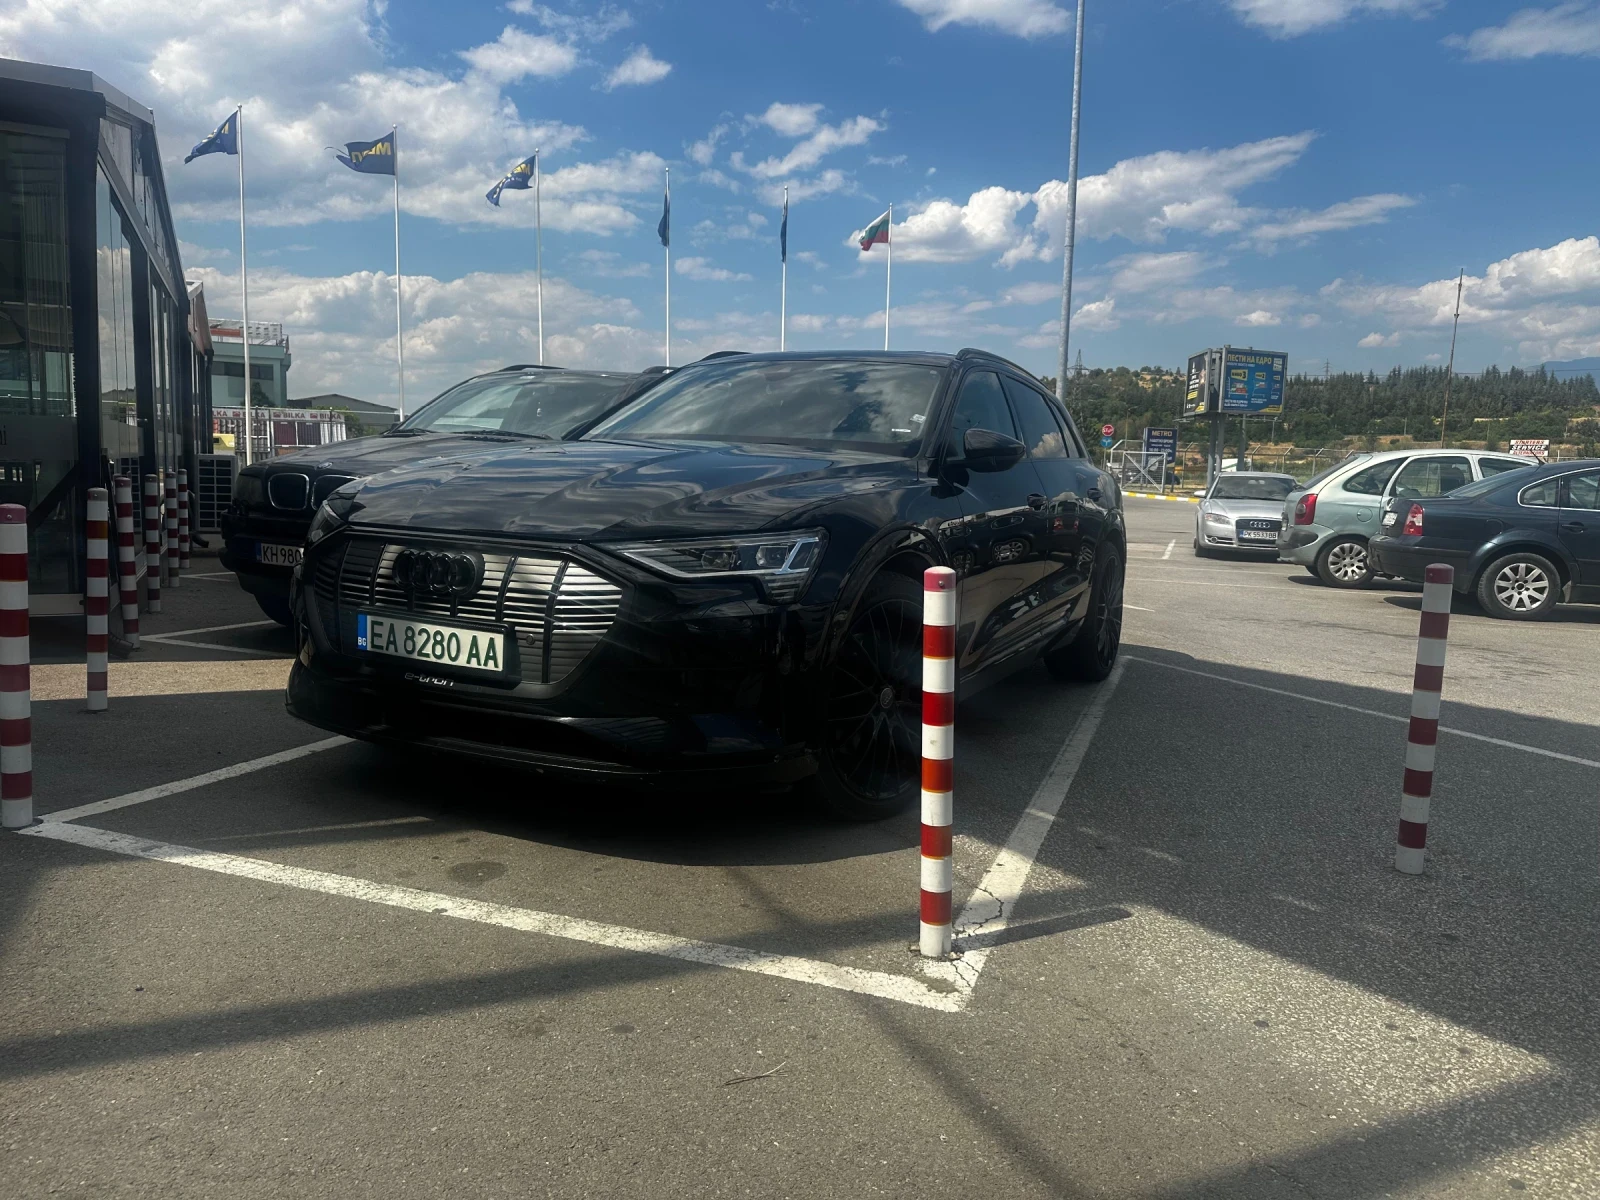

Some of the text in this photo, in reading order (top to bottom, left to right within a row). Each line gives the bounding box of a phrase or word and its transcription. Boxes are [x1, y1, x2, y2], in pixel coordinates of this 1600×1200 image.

[1227, 354, 1246, 362] ПЕСТИ
[1247, 355, 1255, 363] НА
[1256, 356, 1272, 365] ЕДРО
[283, 411, 306, 419] BILKA
[320, 412, 341, 420] BILKA
[262, 545, 279, 563] KH
[357, 636, 367, 646] BG
[370, 620, 499, 669] EA 8280 AA
